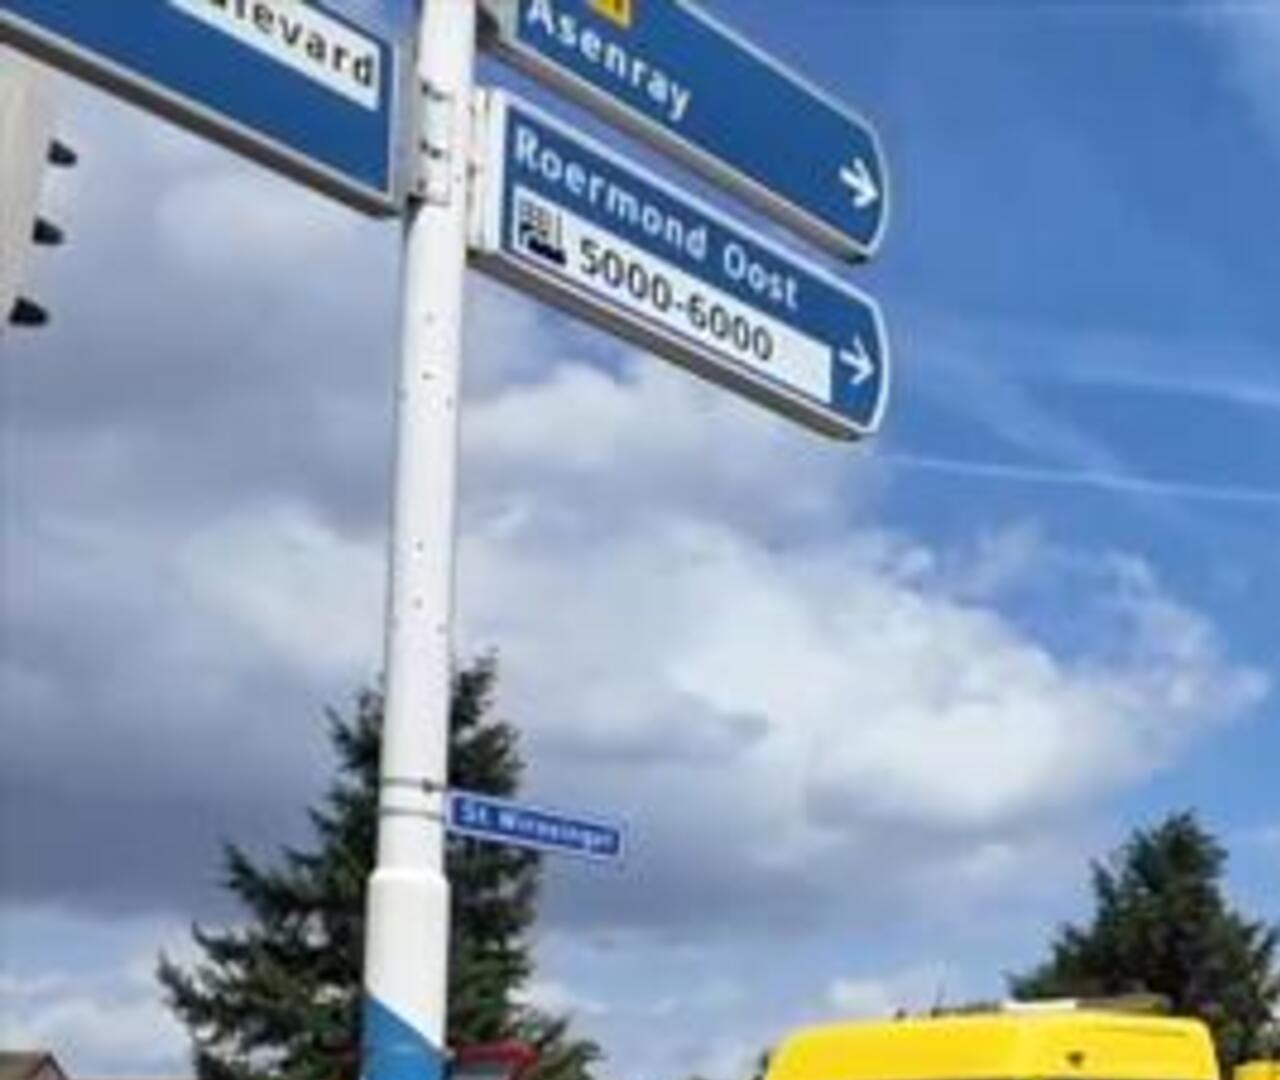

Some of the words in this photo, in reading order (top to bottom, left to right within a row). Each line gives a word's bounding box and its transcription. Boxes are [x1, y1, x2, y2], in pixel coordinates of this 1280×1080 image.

[208, 0, 374, 88] levard
[526, 0, 691, 122] Asenray
[515, 126, 708, 262] Roermond
[723, 242, 800, 310] Oost
[579, 238, 775, 361] 5000-6000
